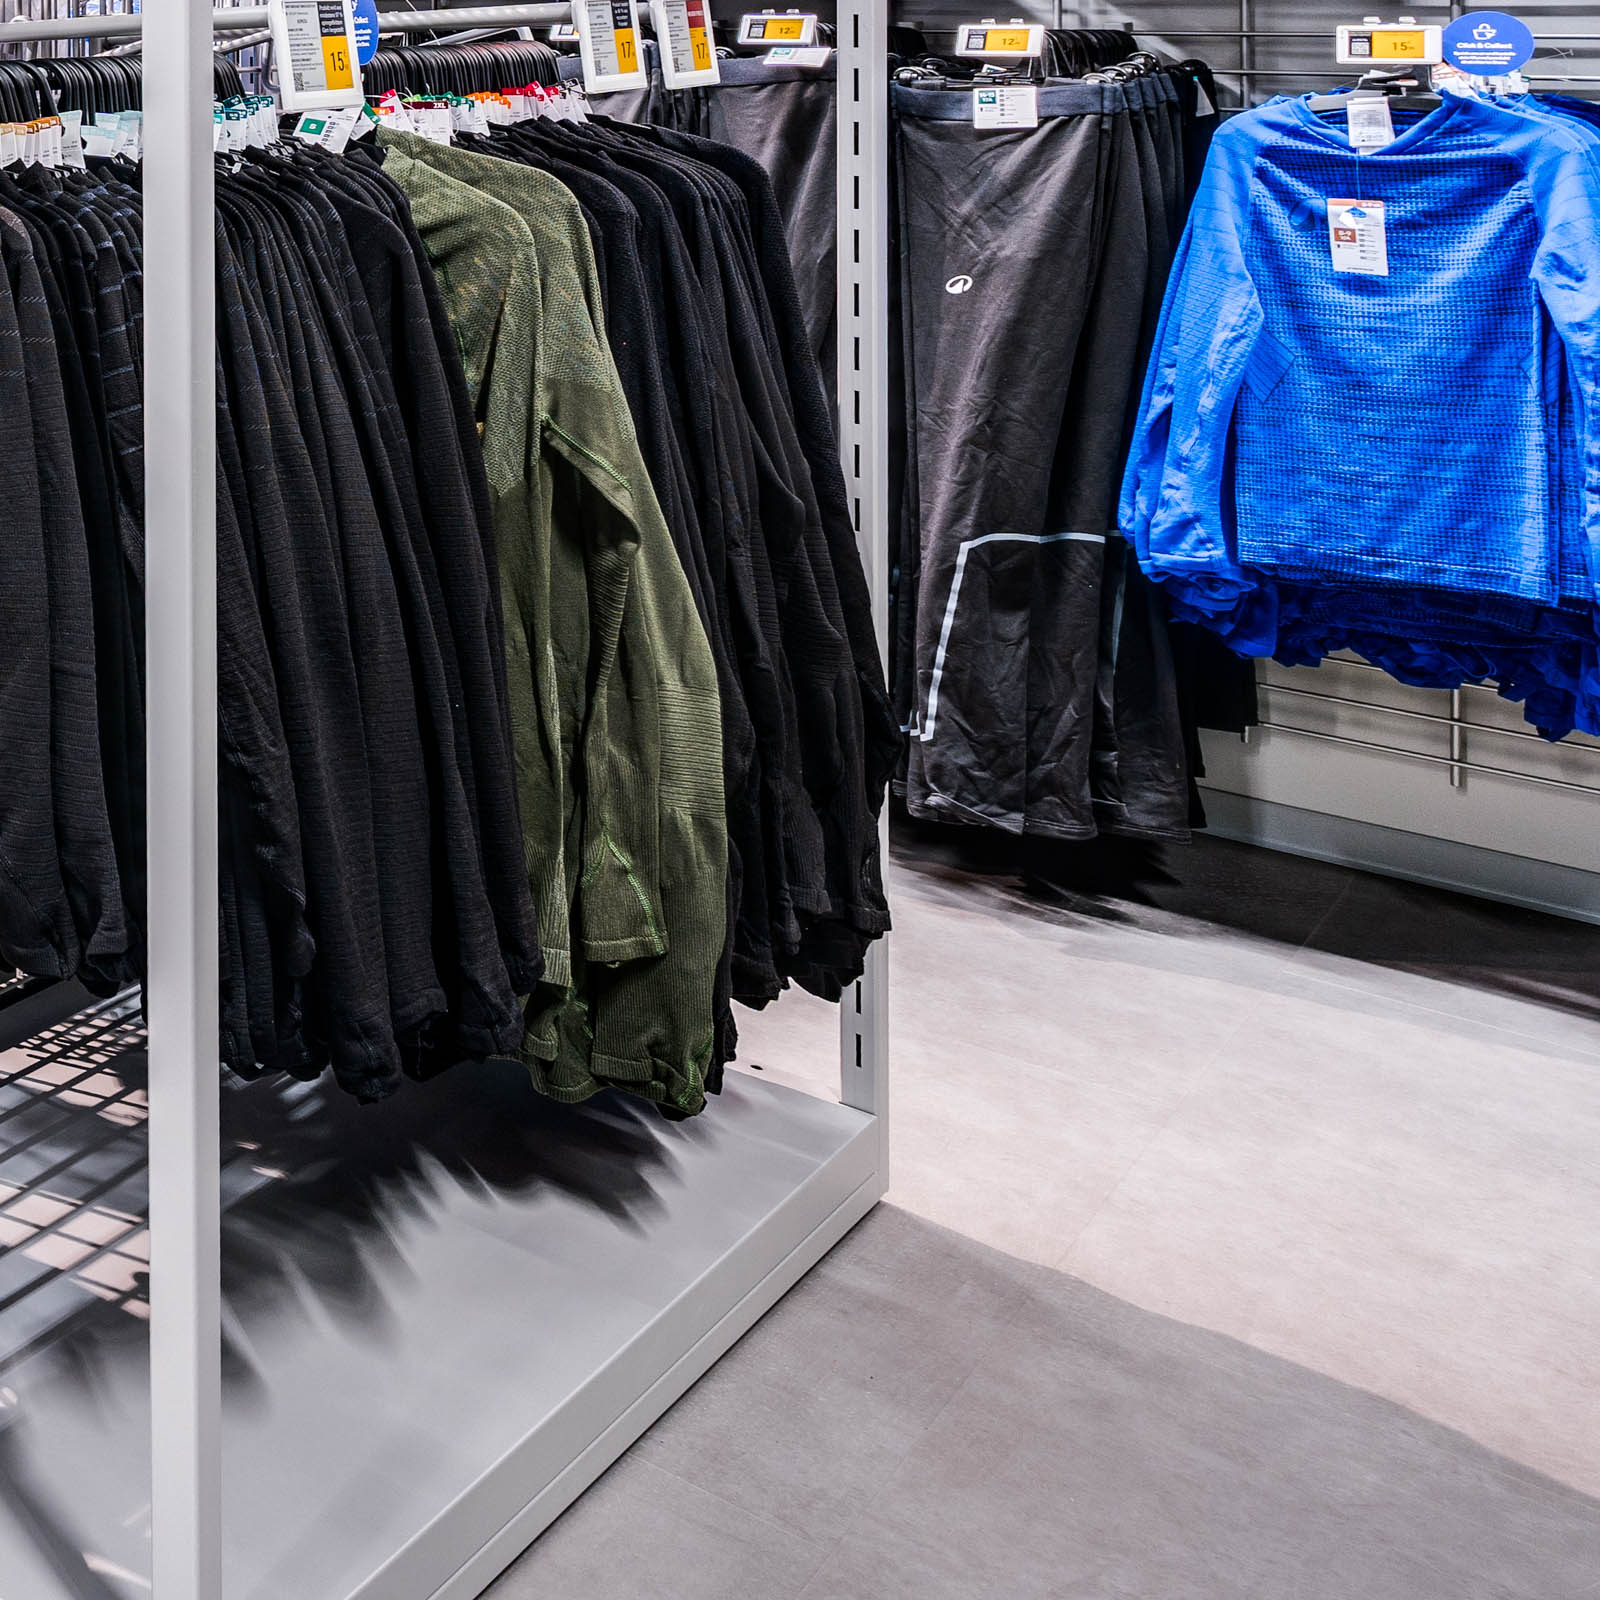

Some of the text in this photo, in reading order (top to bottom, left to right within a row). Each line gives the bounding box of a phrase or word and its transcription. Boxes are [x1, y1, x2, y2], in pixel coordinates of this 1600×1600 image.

[780, 27, 791, 35] 12
[1002, 38, 1015, 47] 12
[1392, 42, 1407, 51] 15
[621, 41, 632, 59] 17
[696, 43, 705, 59] 17
[330, 51, 345, 72] 15
